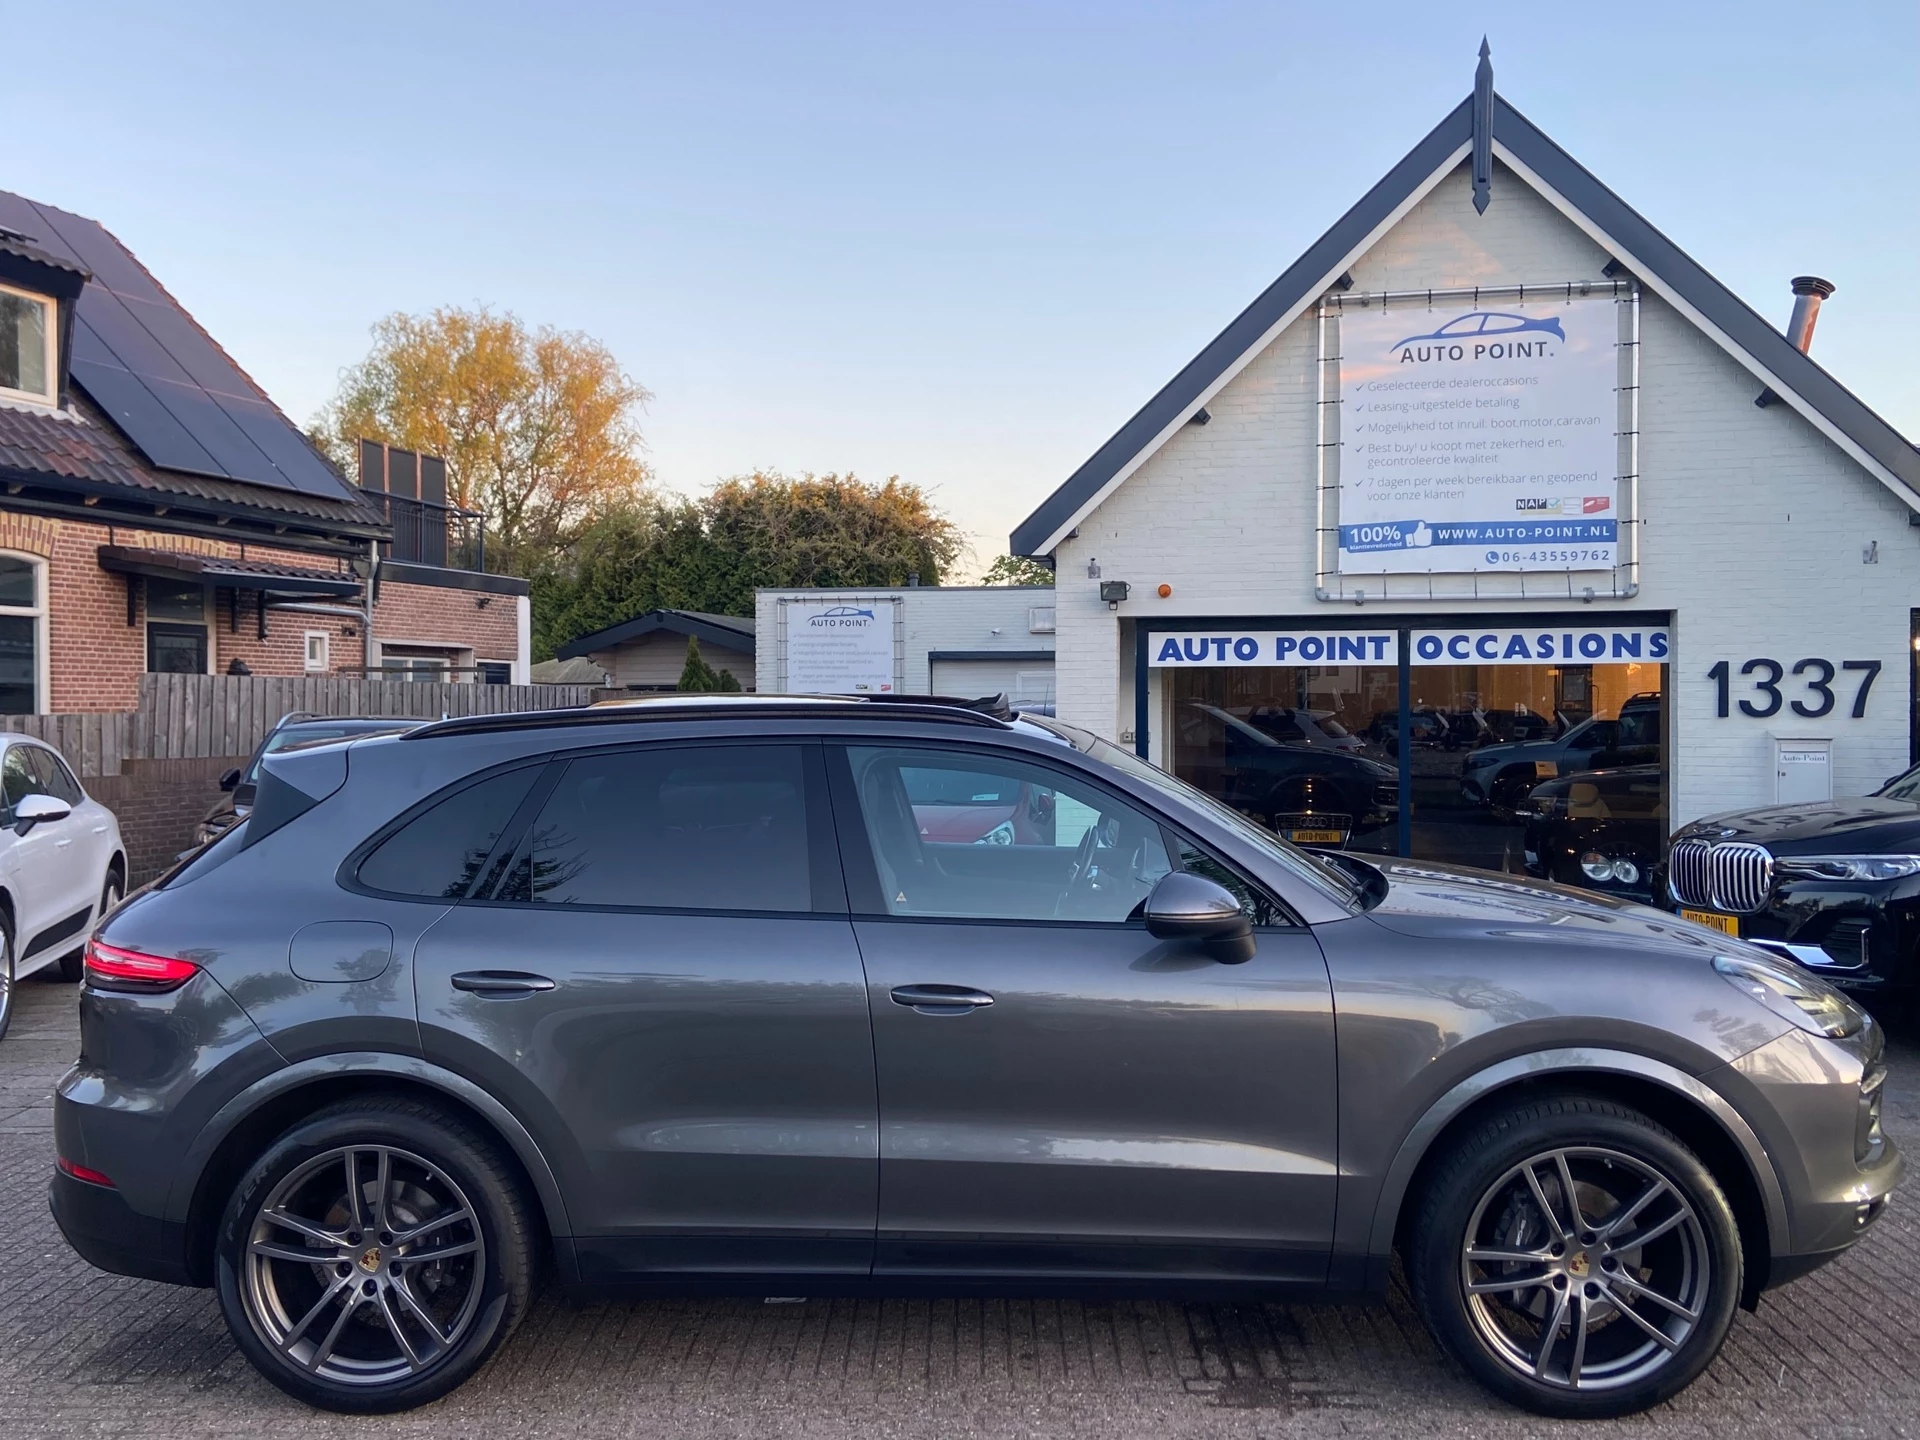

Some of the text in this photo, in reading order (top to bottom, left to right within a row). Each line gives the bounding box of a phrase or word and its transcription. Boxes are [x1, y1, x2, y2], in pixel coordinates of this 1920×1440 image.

[1400, 345, 1464, 363] AUTO
[1367, 376, 1539, 392] Geselecteerde dealeroccasions
[1367, 397, 1520, 414] Leasing-uitgestelde betaling
[1367, 421, 1436, 434] Mogelijkheid
[1438, 421, 1454, 430] tot
[1367, 443, 1391, 453] Best
[1394, 442, 1417, 454] buy!
[1420, 444, 1428, 452] u
[1430, 441, 1462, 452] koopt
[1465, 440, 1487, 450] met
[1490, 438, 1545, 449] zekerheid
[1367, 454, 1499, 470] gecontroleerde kwaliteit
[1368, 471, 1598, 489] 7 dagen per week bereikbaar en geopend
[1367, 489, 1465, 501] voor onze klanten
[1516, 498, 1547, 510] NAP
[1350, 525, 1401, 543] 100%
[1438, 526, 1610, 539] WWW.AUTO-POINT.NL
[1502, 550, 1609, 562] 06-43559762
[810, 619, 836, 627] AUTO
[1157, 635, 1391, 661] AUTO POINT
[1416, 632, 1668, 660] OCCASIONS
[1707, 658, 1882, 718] 1337
